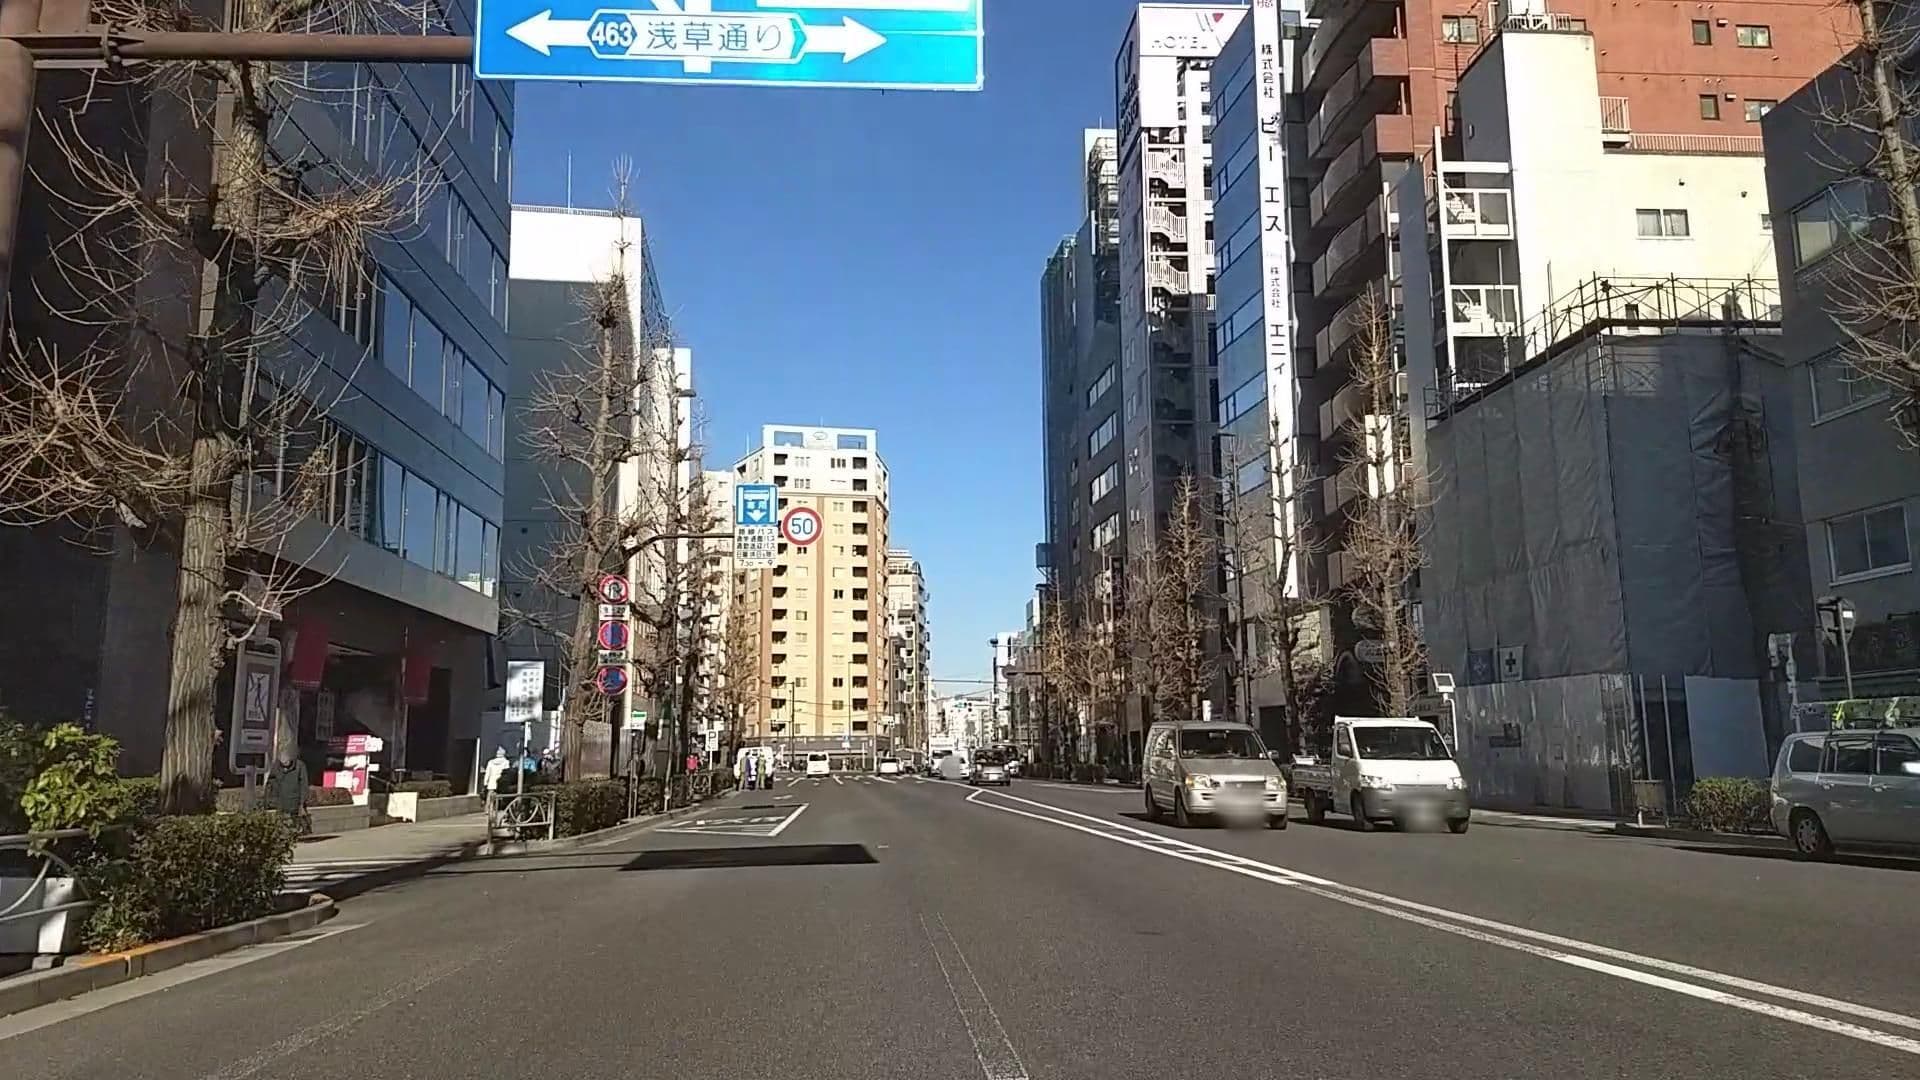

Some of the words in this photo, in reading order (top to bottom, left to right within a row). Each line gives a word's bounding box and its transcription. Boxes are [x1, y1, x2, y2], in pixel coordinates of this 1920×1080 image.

[591, 21, 633, 47] 463
[647, 21, 781, 51] 浅草通り
[791, 517, 814, 535] 50
